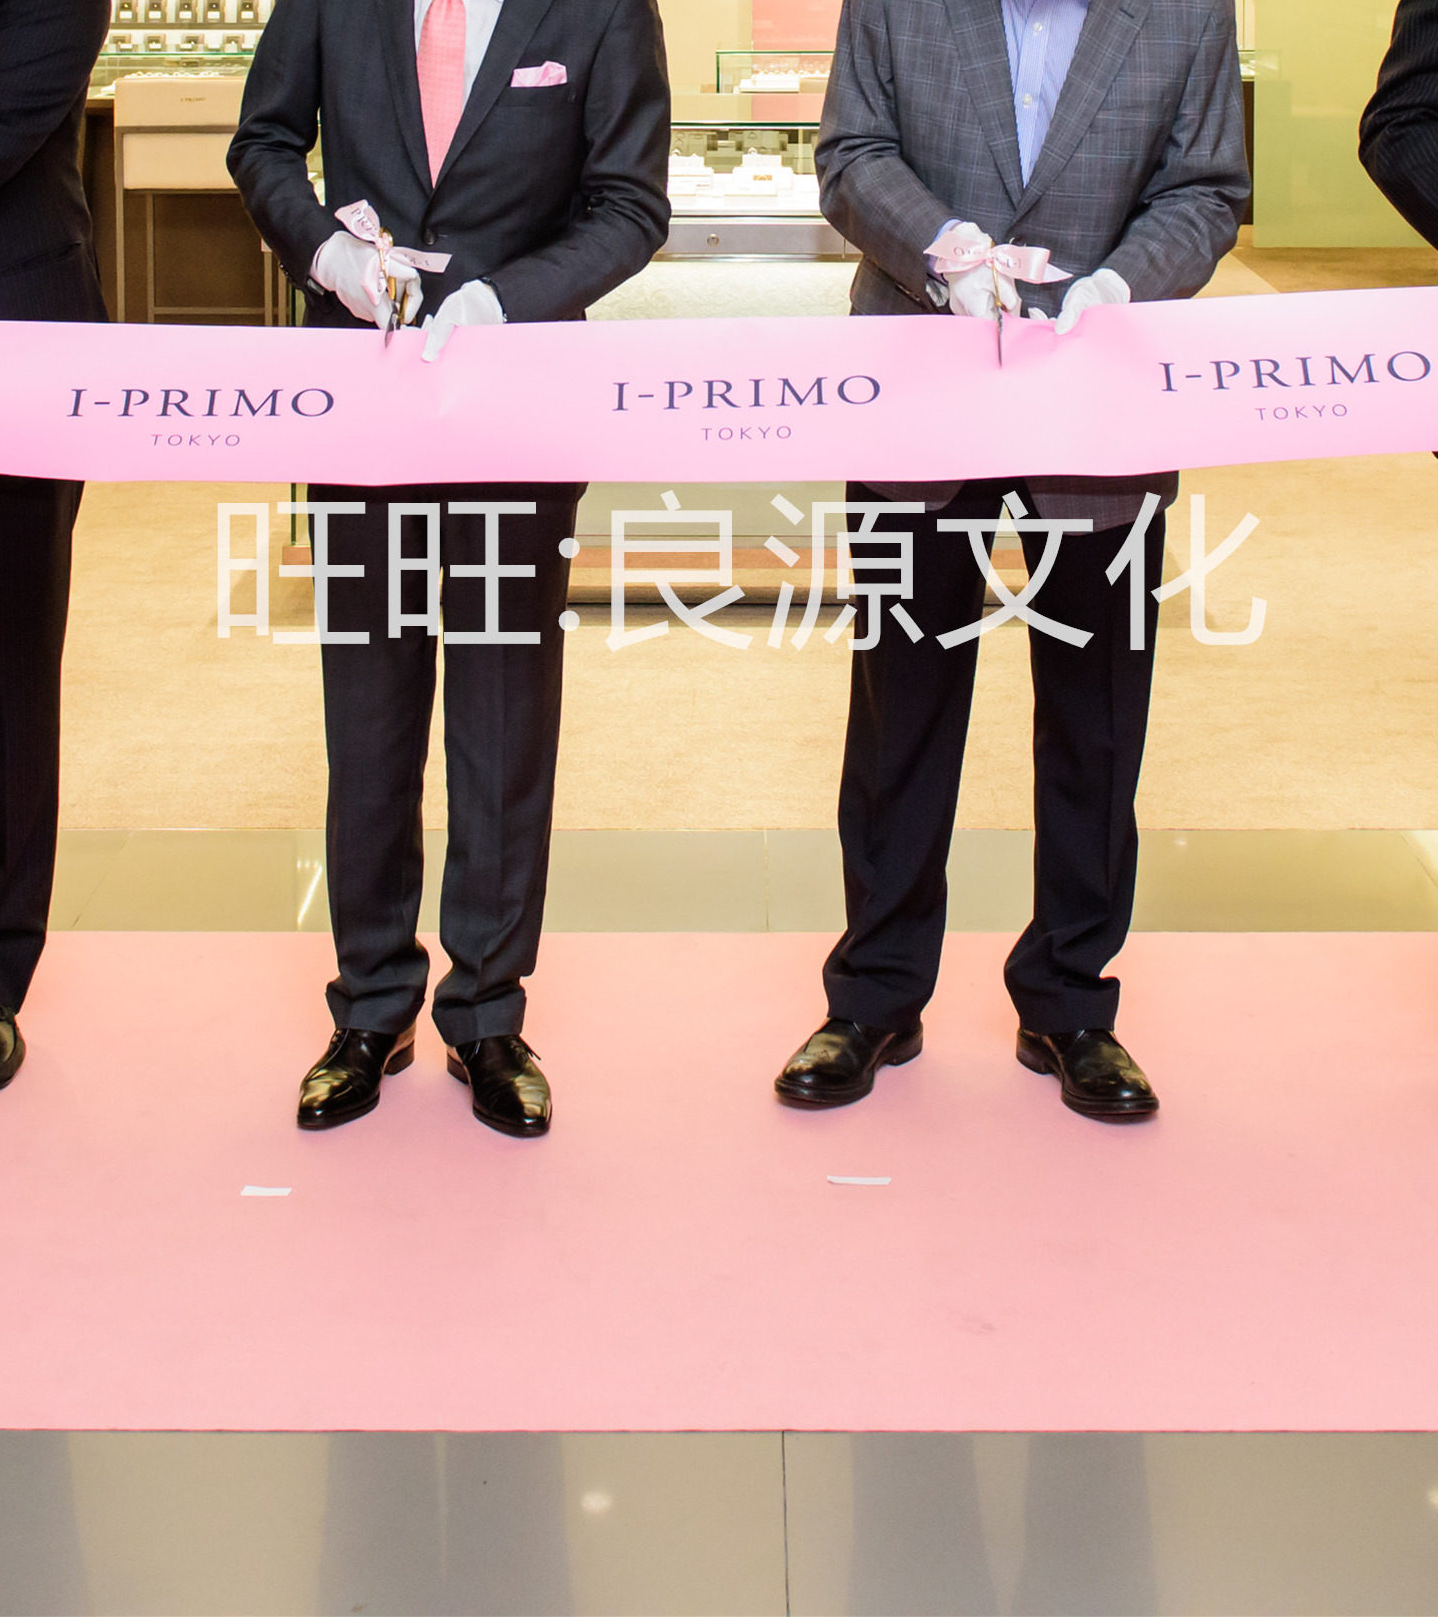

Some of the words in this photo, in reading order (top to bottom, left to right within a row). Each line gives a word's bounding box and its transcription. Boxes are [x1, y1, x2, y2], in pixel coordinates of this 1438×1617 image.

[1158, 350, 1432, 392] I-PRIMO
[67, 388, 335, 418] I-PRIMO
[611, 374, 881, 412] I-PRIMO
[1255, 403, 1349, 421] TOKYO
[151, 434, 241, 447] TOKYO
[702, 426, 792, 441] TOKYO
